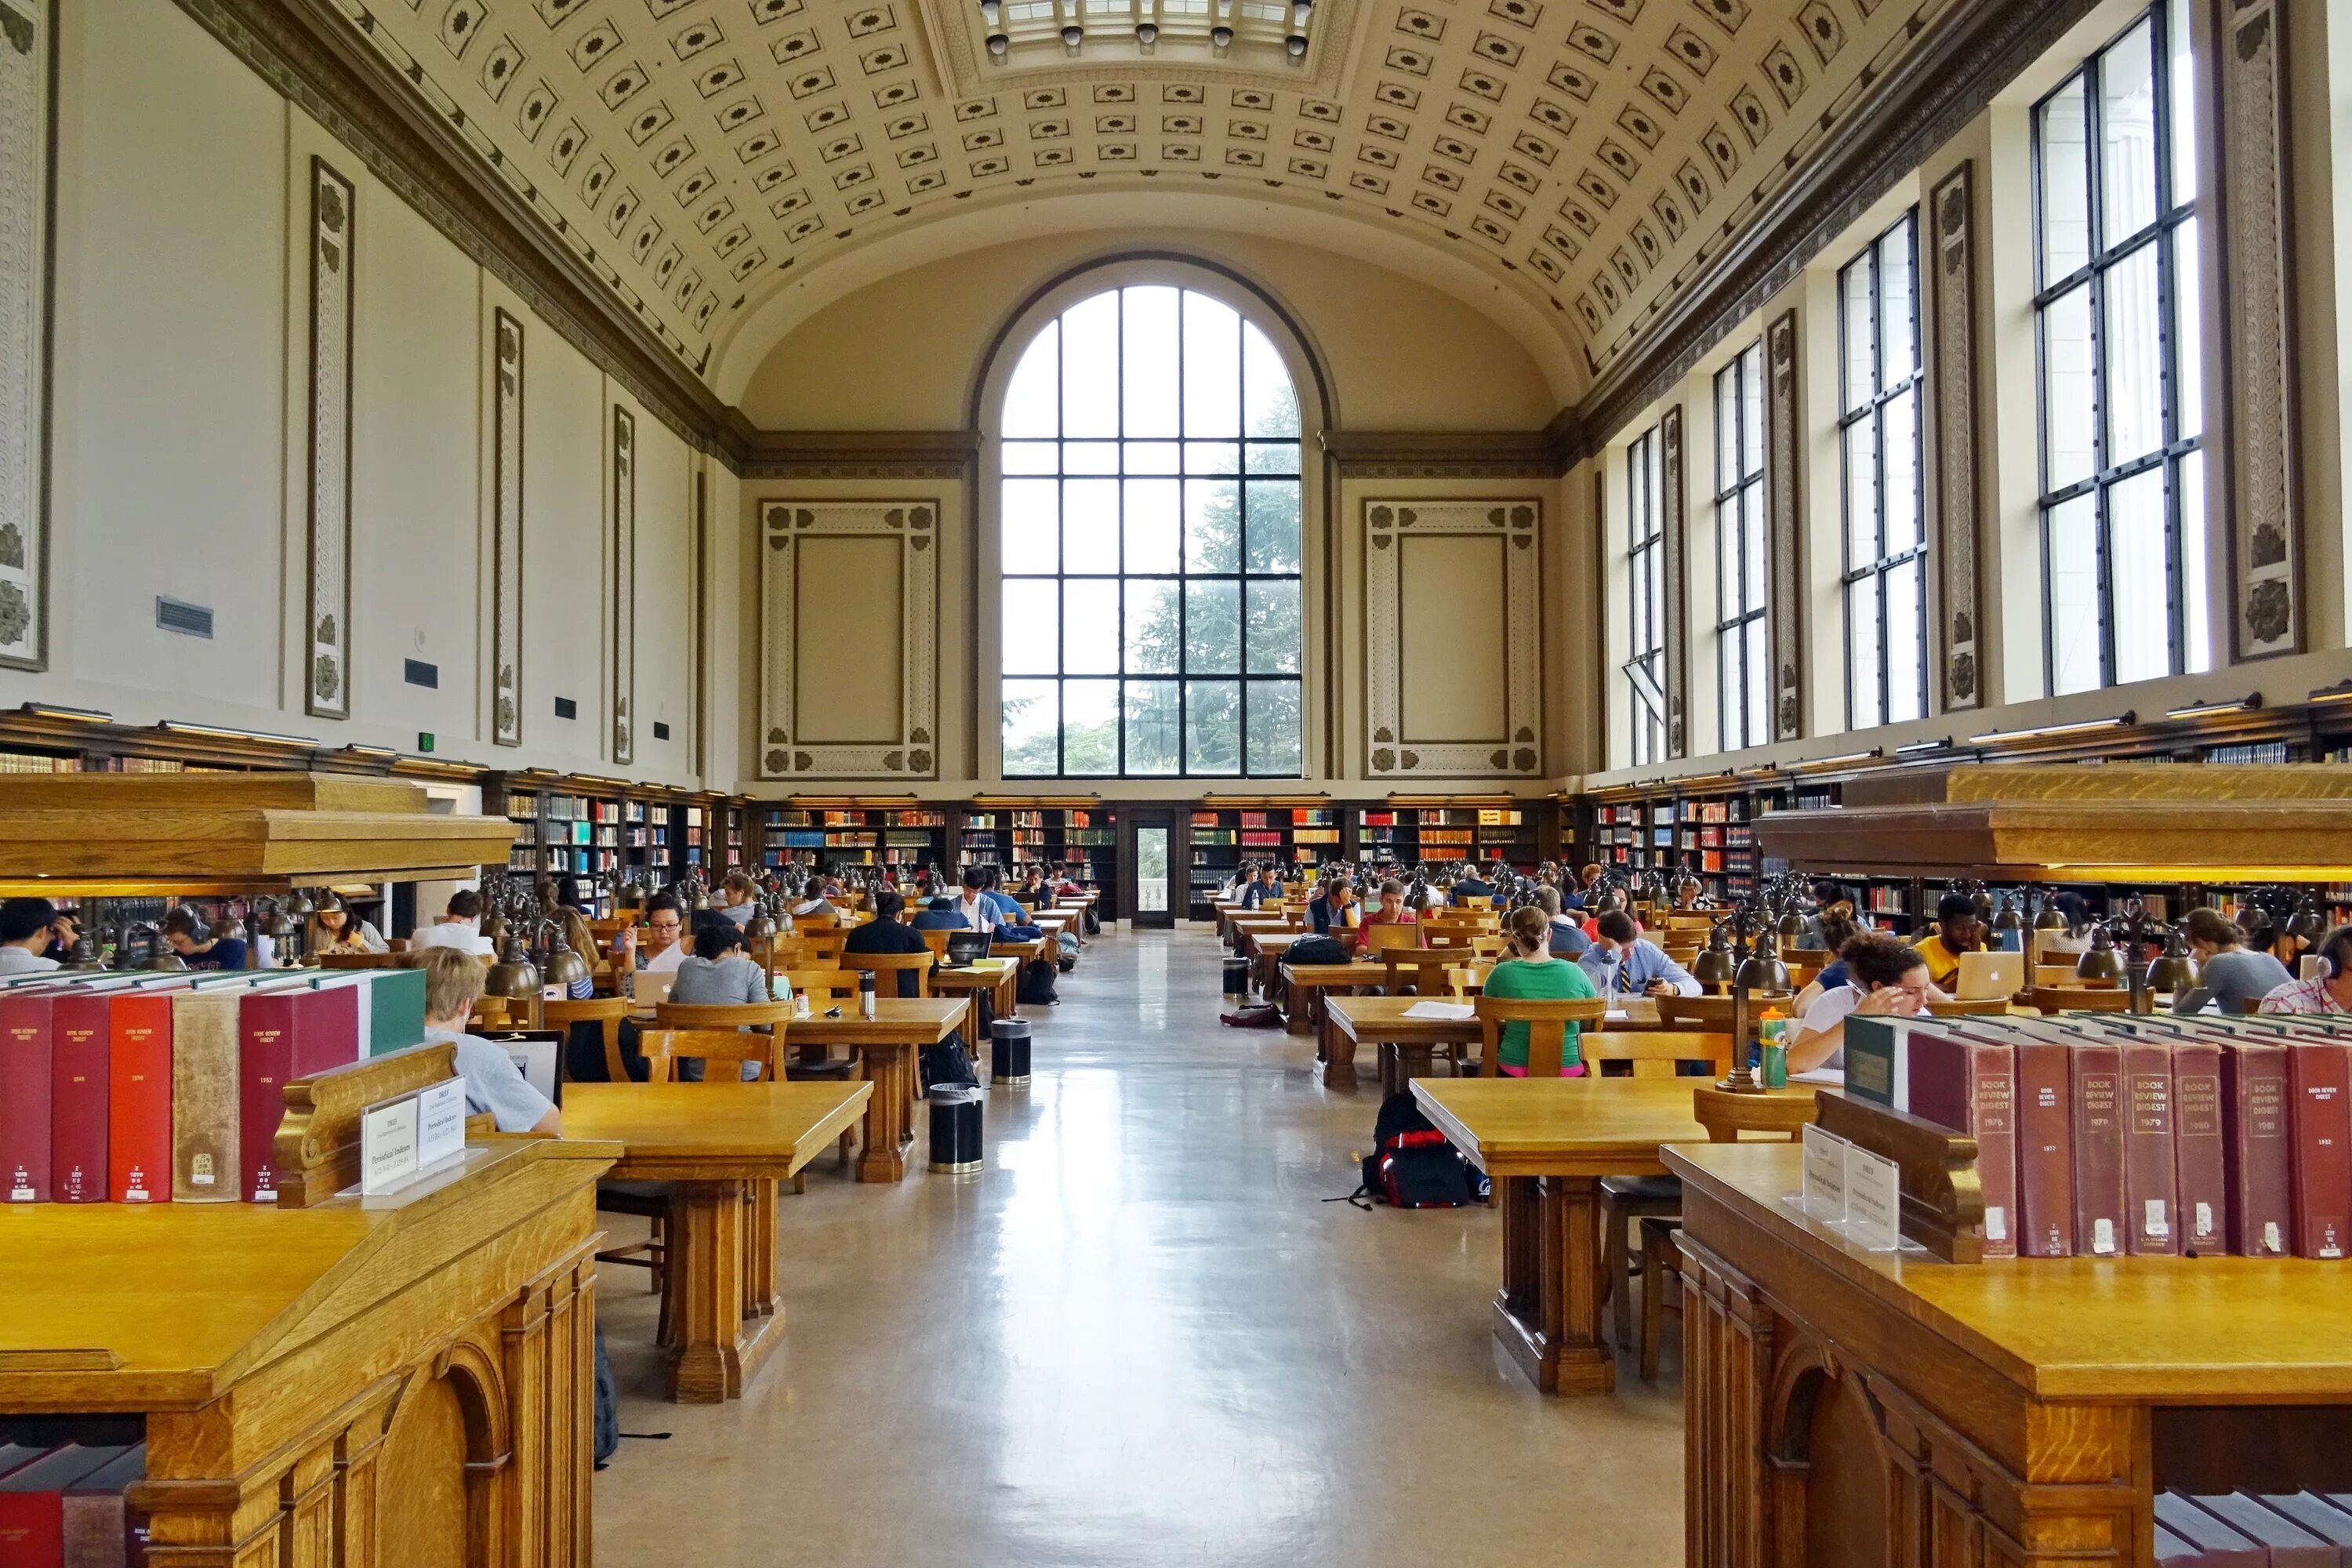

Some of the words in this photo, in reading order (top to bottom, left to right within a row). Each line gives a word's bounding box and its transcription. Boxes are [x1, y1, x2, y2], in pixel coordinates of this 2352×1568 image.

[2255, 1084, 2277, 1093] BOOK
[1979, 1091, 2009, 1100] REVIEW
[2085, 1091, 2114, 1099] REVIEW
[2134, 1092, 2167, 1101] REVIEW
[2183, 1093, 2215, 1102] REVIEW
[2252, 1095, 2280, 1104] REVIEW
[1980, 1102, 2009, 1110] DIGEST
[2136, 1103, 2166, 1112] DIGEST
[2184, 1103, 2214, 1112] DIGEST
[2253, 1106, 2278, 1115] DIGEST
[372, 1148, 394, 1164] Periodical
[394, 1144, 411, 1156] Indexes
